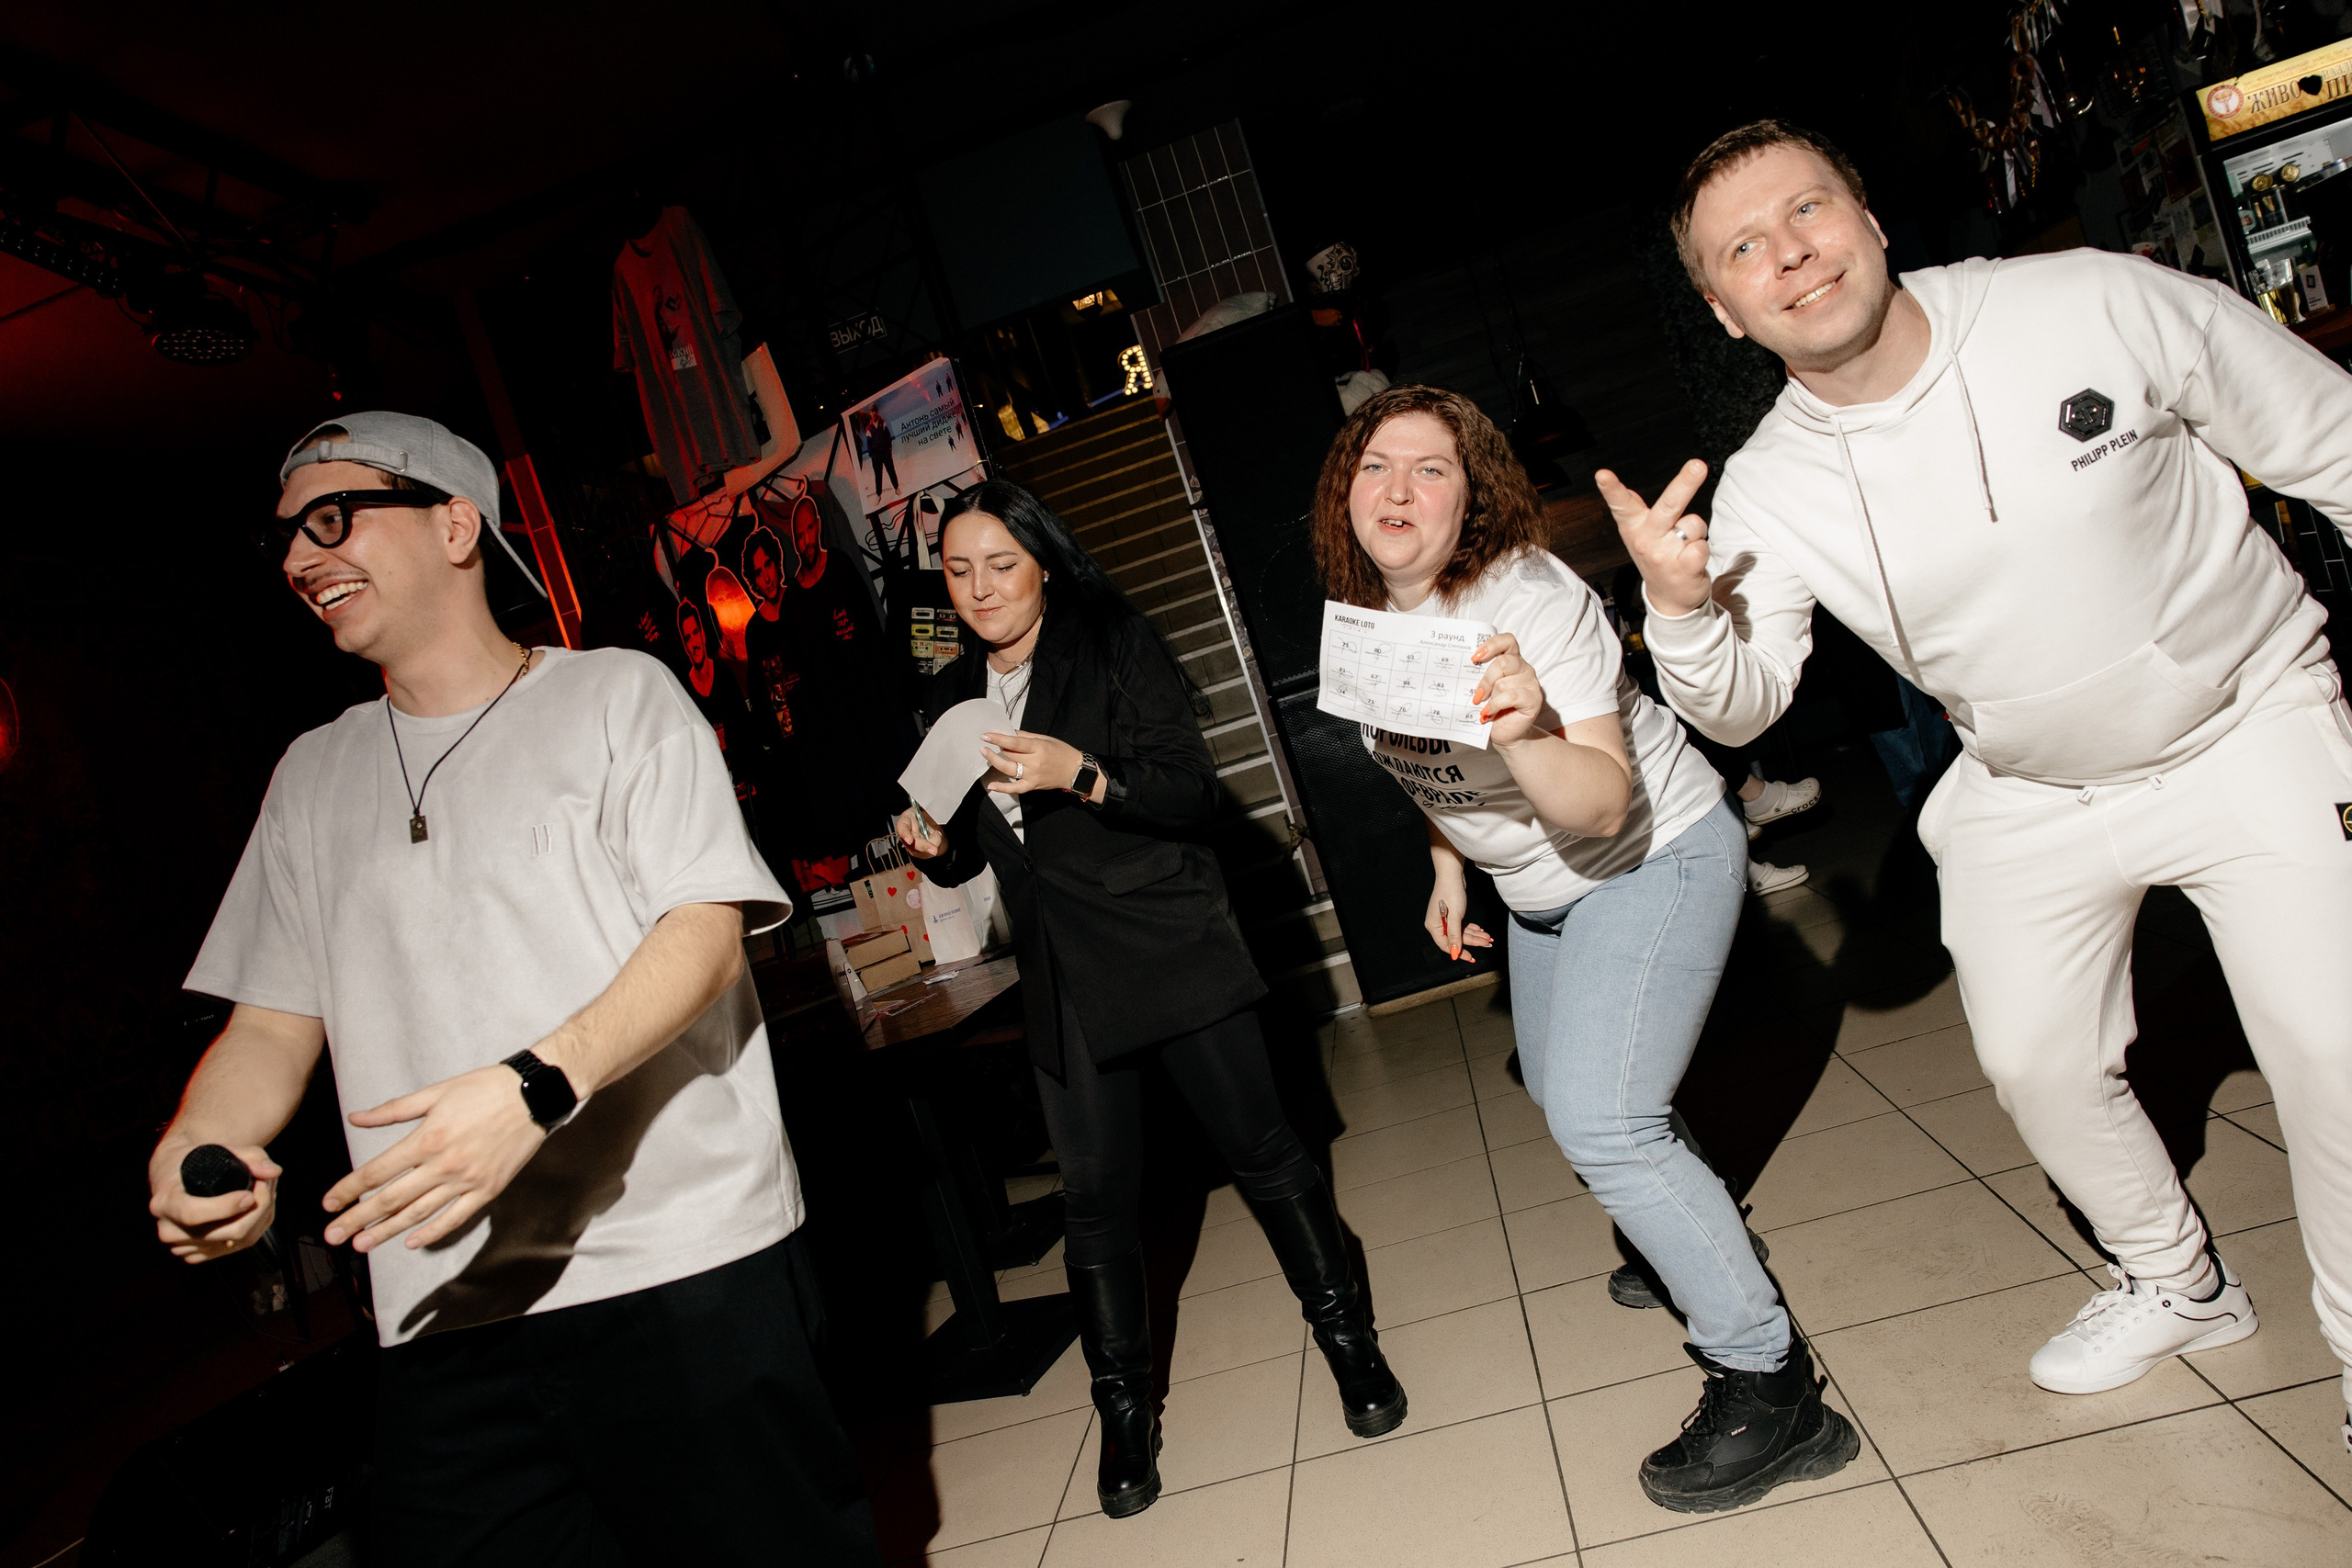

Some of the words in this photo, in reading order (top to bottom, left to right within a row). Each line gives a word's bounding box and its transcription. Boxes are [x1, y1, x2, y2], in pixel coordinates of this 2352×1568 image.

[2247, 79, 2302, 114] ЖИВО
[830, 315, 885, 348] ВЫХОД
[929, 397, 956, 417] самый
[918, 436, 929, 446] на
[929, 425, 953, 442] свете
[2071, 444, 2109, 472] PHILIPP
[2109, 429, 2139, 452] PLEIN
[1334, 614, 1360, 626] KARAOKE
[1360, 620, 1375, 629] LOTO
[1430, 630, 1436, 638] 3
[1438, 632, 1465, 642] раунд
[1369, 750, 1465, 784] ОЖДАЮТСЯ
[1791, 795, 1819, 814] crocs
